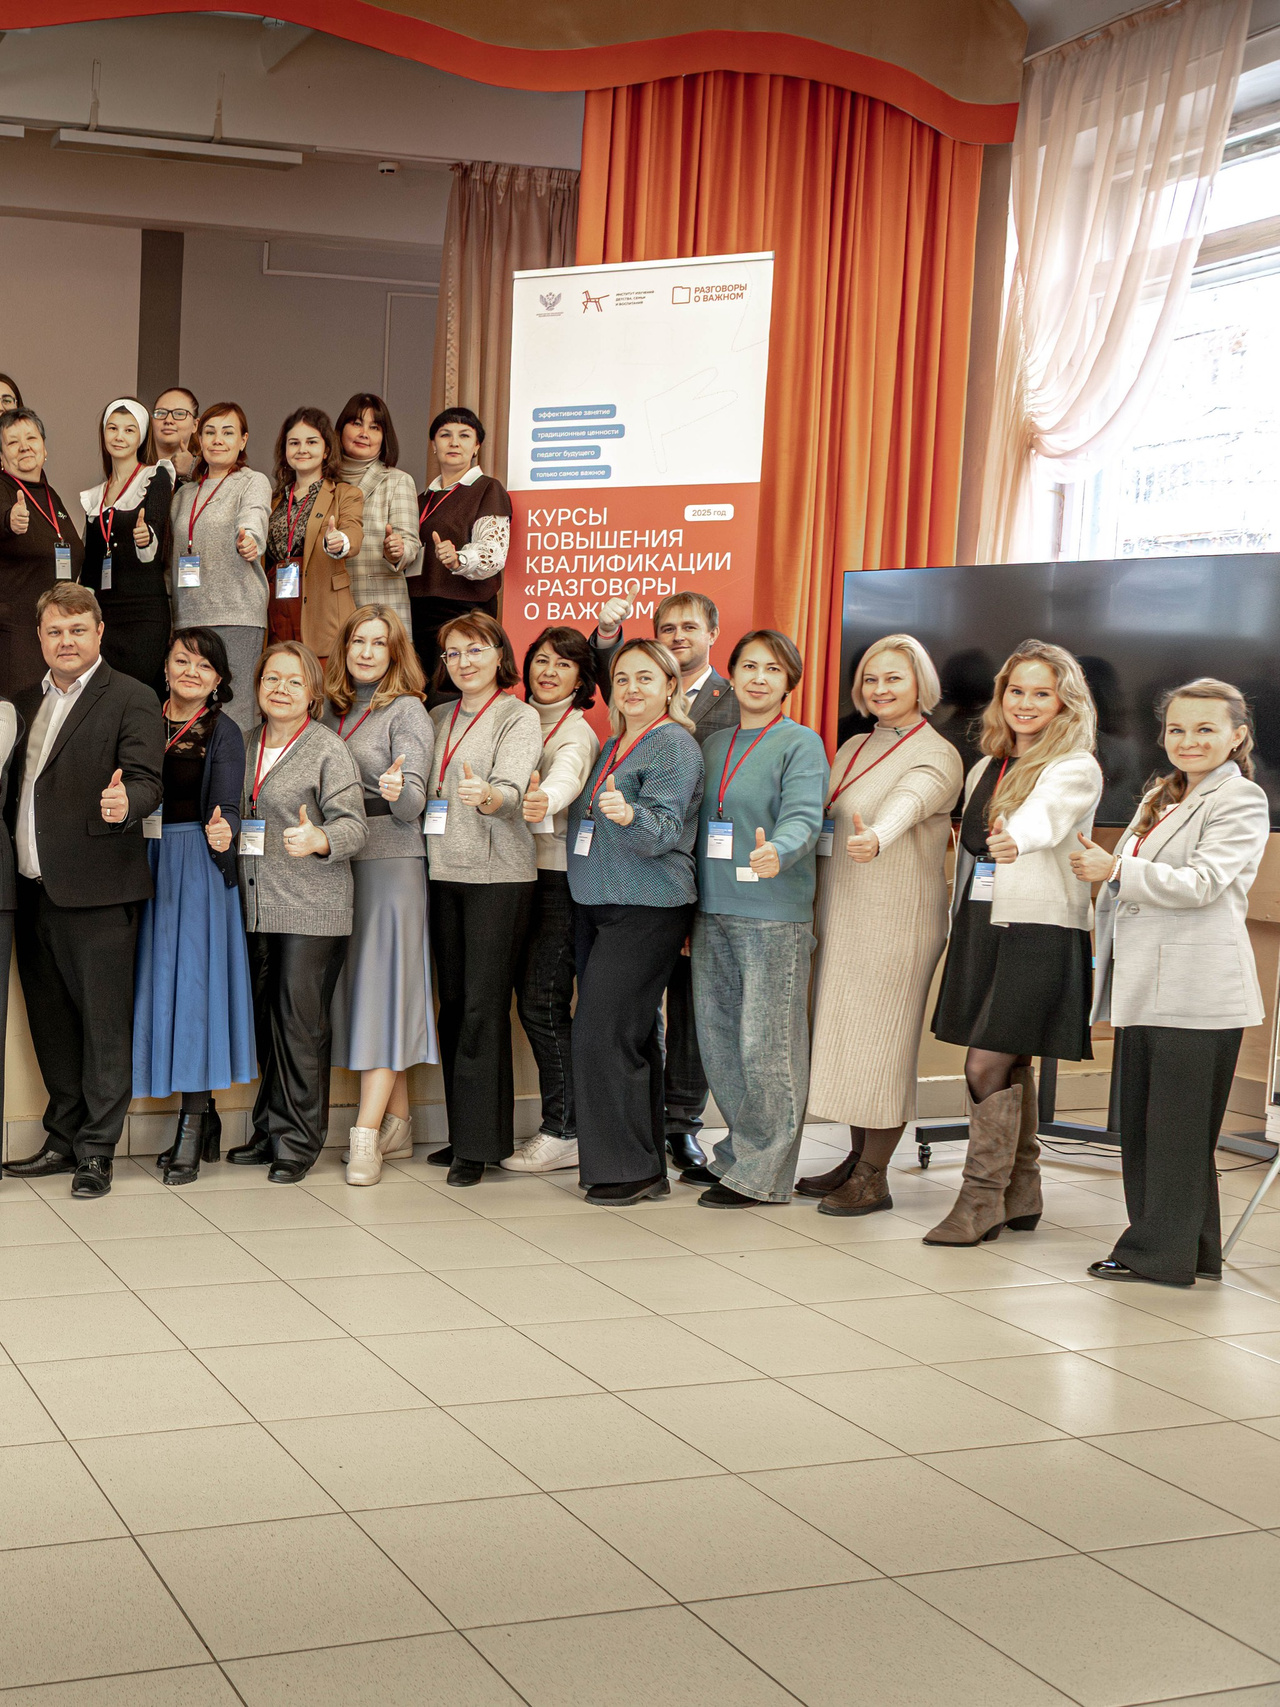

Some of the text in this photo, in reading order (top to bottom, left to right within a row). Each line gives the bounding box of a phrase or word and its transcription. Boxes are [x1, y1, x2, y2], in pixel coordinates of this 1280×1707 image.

[694, 283, 747, 294] РАЗГОВОРЫ
[703, 292, 743, 302] ВАЖНОМ
[538, 411, 582, 419] эффективное
[538, 430, 586, 439] традиционные
[563, 450, 595, 458] будущего
[527, 507, 607, 527] КУРСЫ
[526, 529, 683, 550] ПОВЫШЕНИЯ
[526, 552, 731, 574] КВАЛИФИКАЦИИ
[524, 577, 676, 597] «РАЗГОВОРЫ
[524, 603, 540, 620] О
